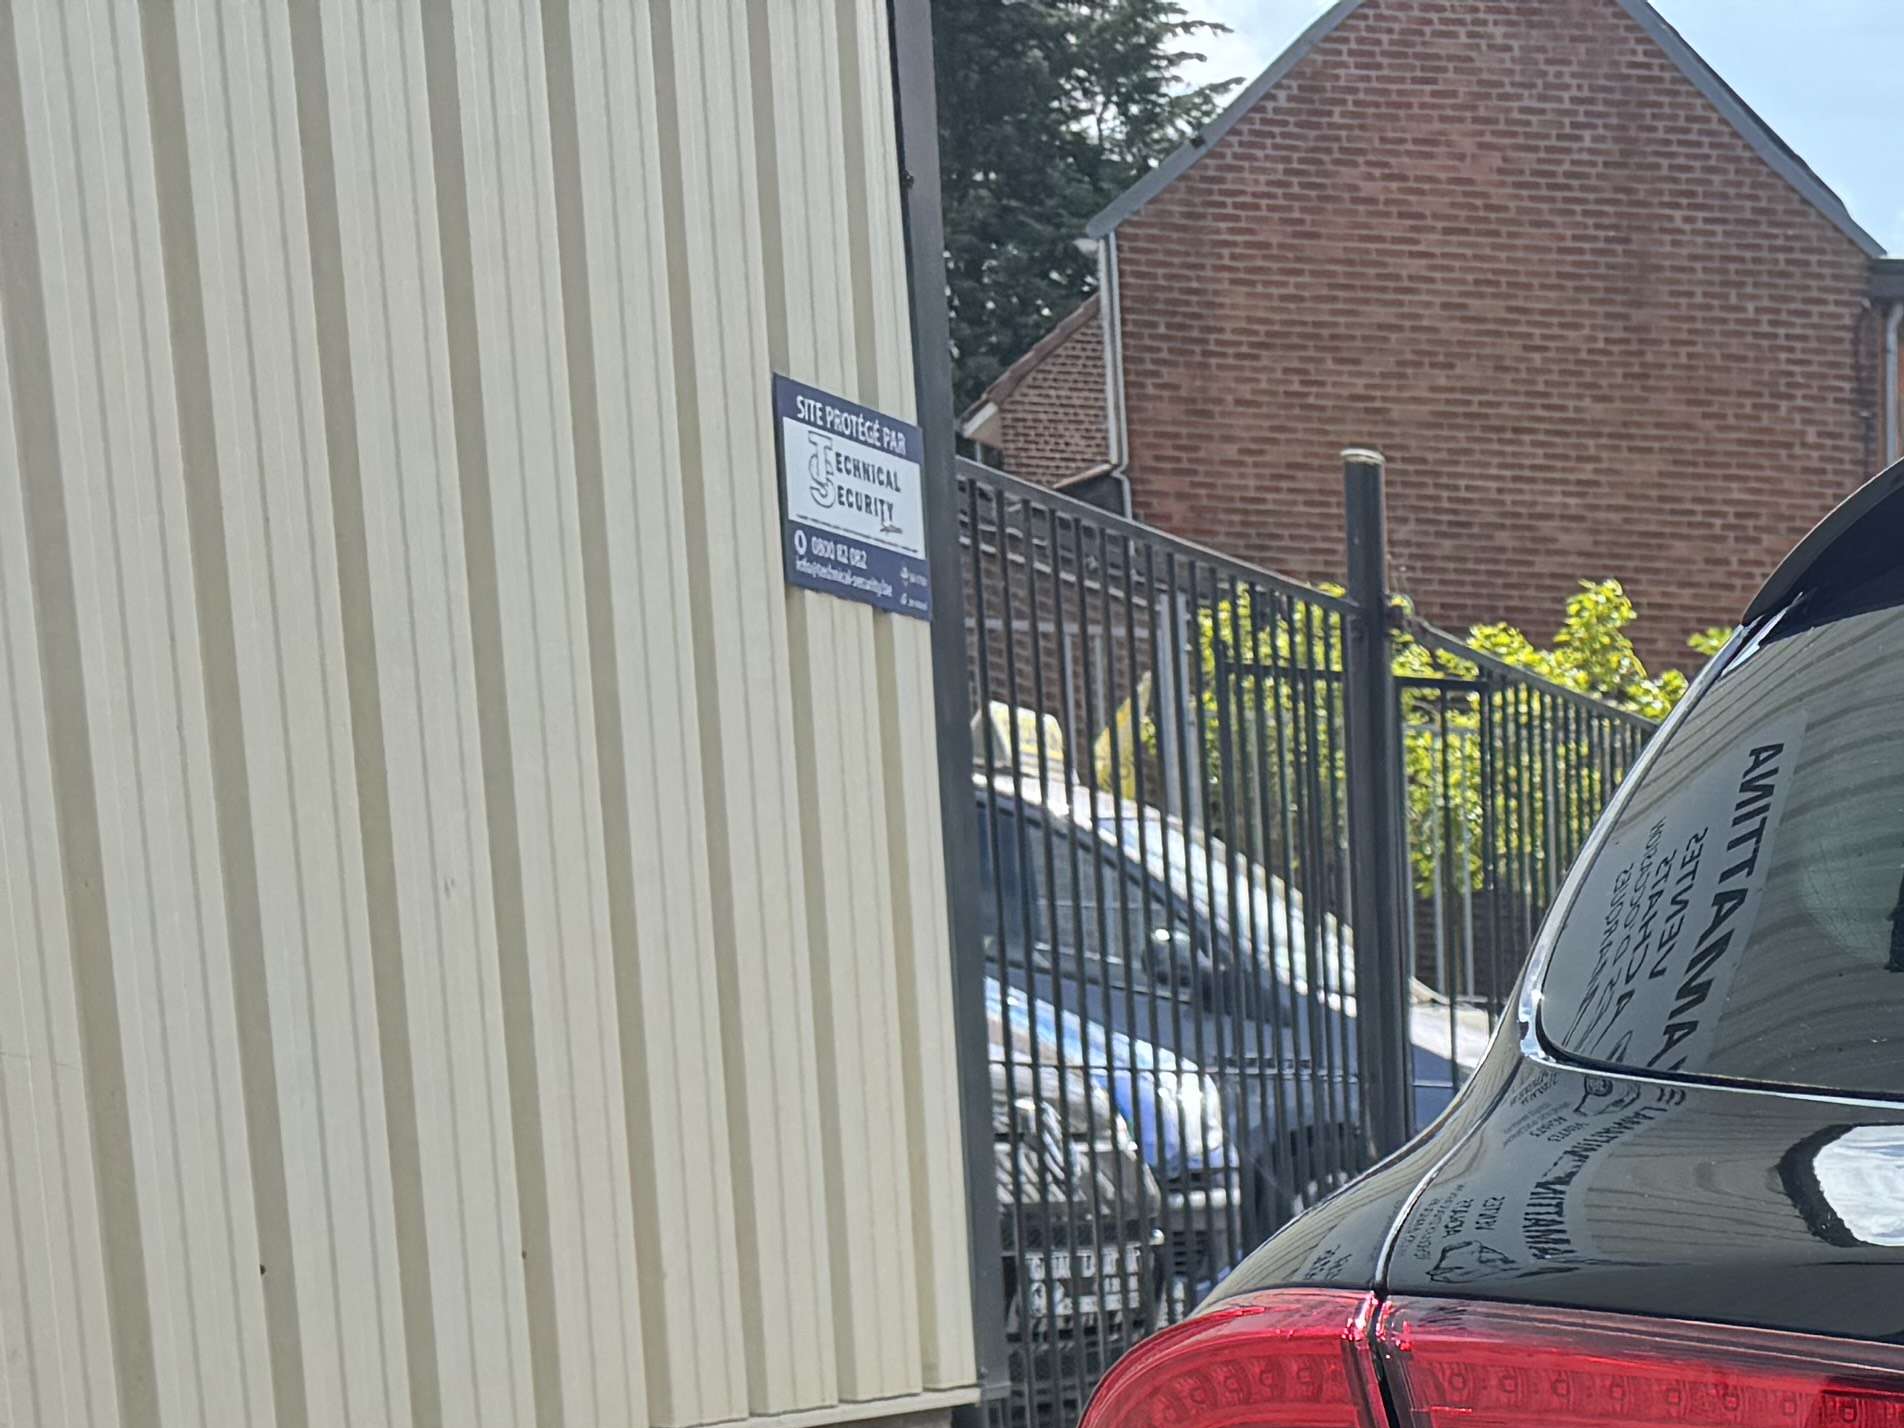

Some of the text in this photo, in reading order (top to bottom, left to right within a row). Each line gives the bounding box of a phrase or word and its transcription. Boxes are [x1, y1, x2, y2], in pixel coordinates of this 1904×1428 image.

[797, 395, 906, 456] SITE PROTÉGÉ PAR
